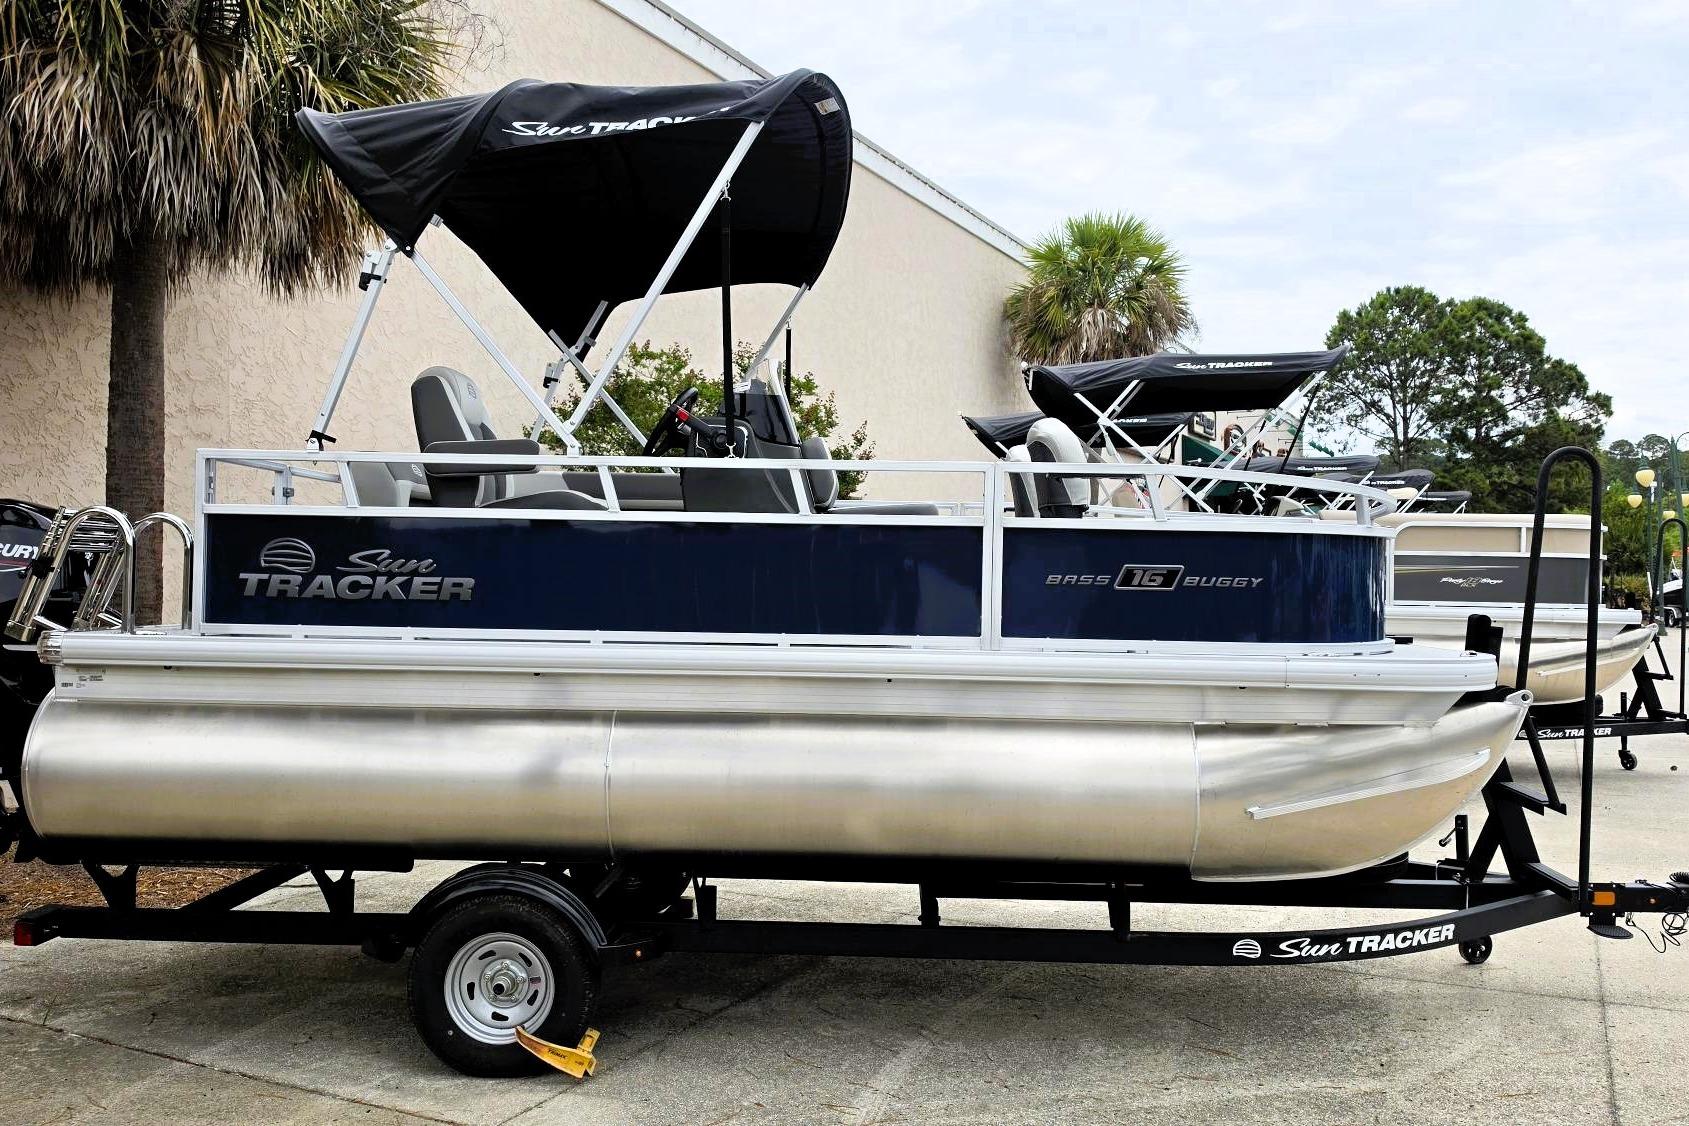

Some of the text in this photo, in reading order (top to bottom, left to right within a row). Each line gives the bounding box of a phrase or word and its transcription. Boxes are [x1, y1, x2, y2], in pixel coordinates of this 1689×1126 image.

[502, 121, 586, 136] Sun
[1207, 361, 1273, 369] TRACKER
[336, 549, 437, 573] Sun
[239, 572, 475, 602] TRACKER
[1045, 569, 1264, 588] BASS 16 BUGGY
[1537, 728, 1612, 738] Sun TRAKER
[1270, 924, 1456, 959] Sun TRACKER
